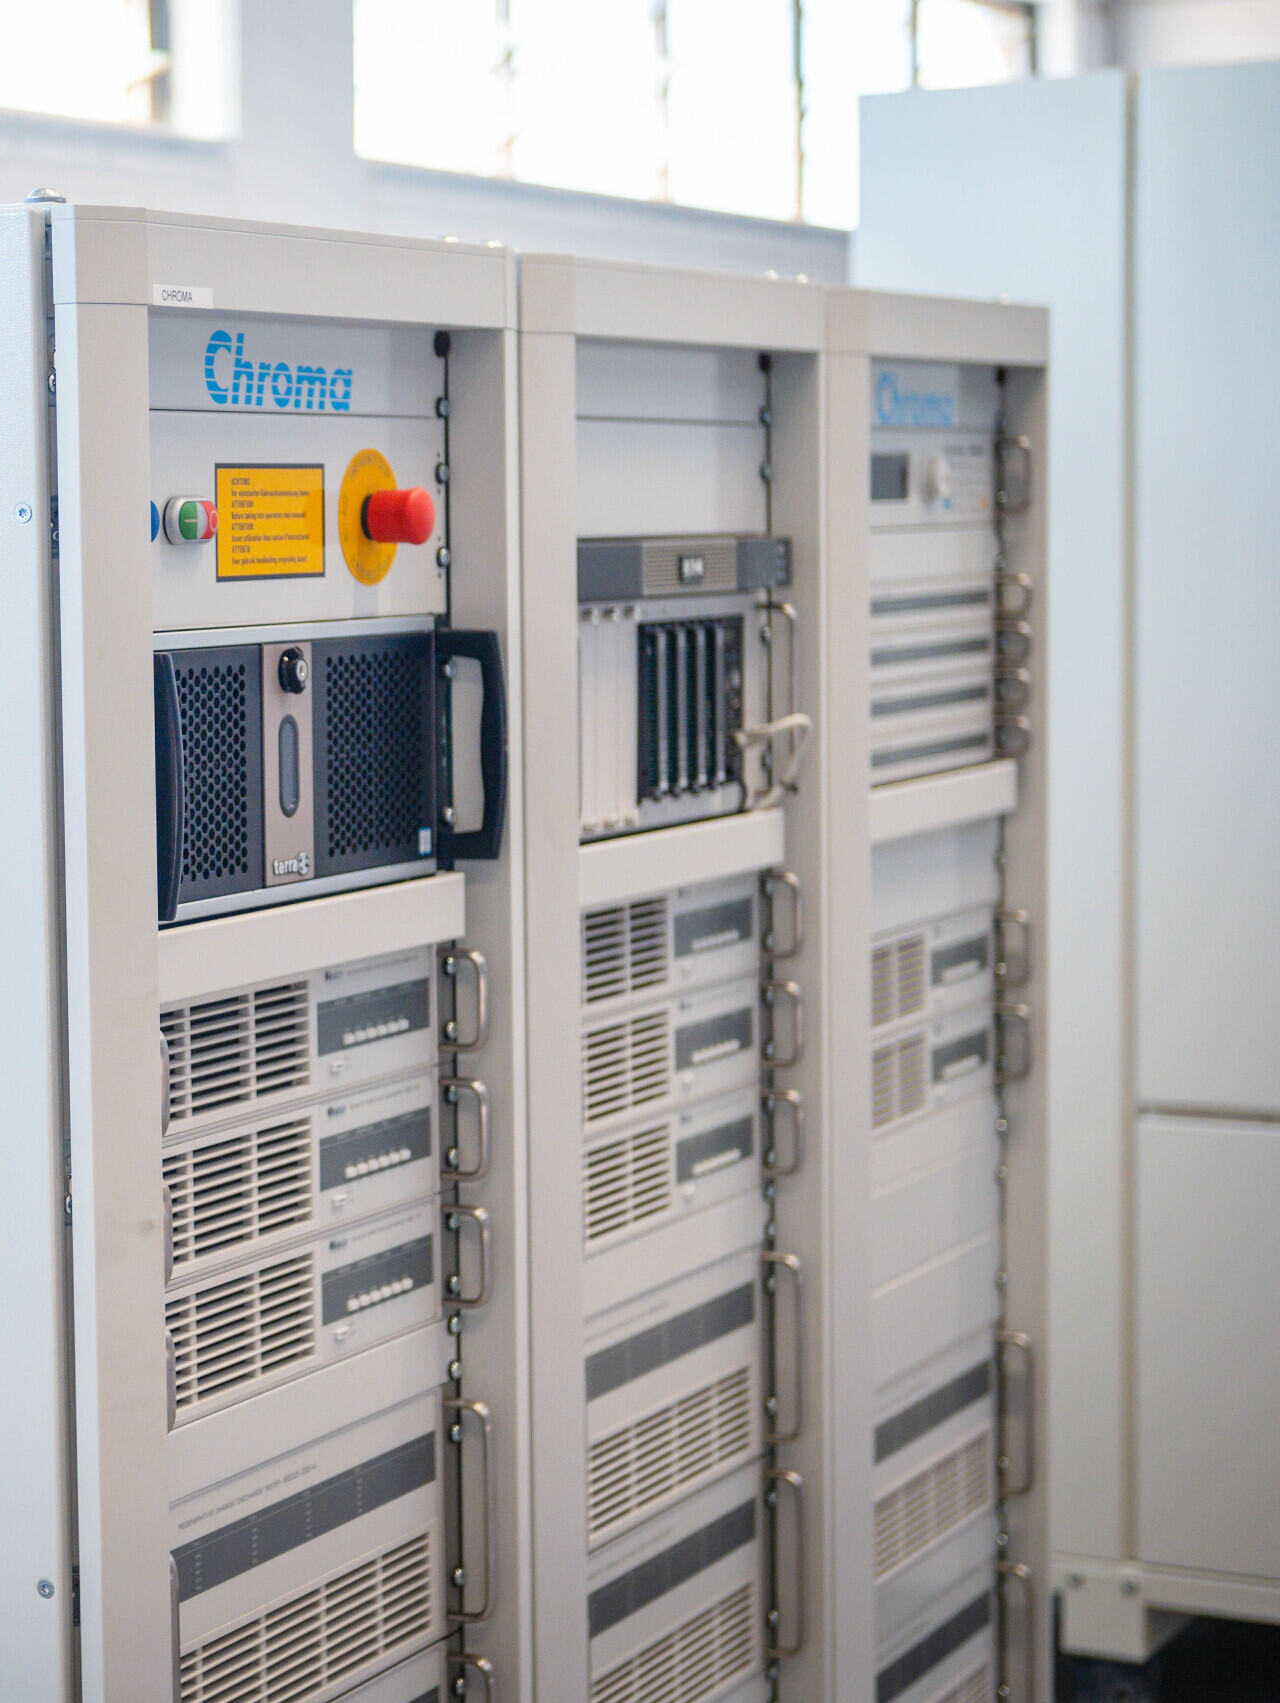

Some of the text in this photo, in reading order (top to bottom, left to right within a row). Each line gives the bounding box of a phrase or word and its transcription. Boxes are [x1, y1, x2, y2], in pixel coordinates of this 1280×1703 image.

[162, 289, 193, 303] CHROMA
[204, 329, 354, 412] Chroma
[273, 857, 299, 875] terra
